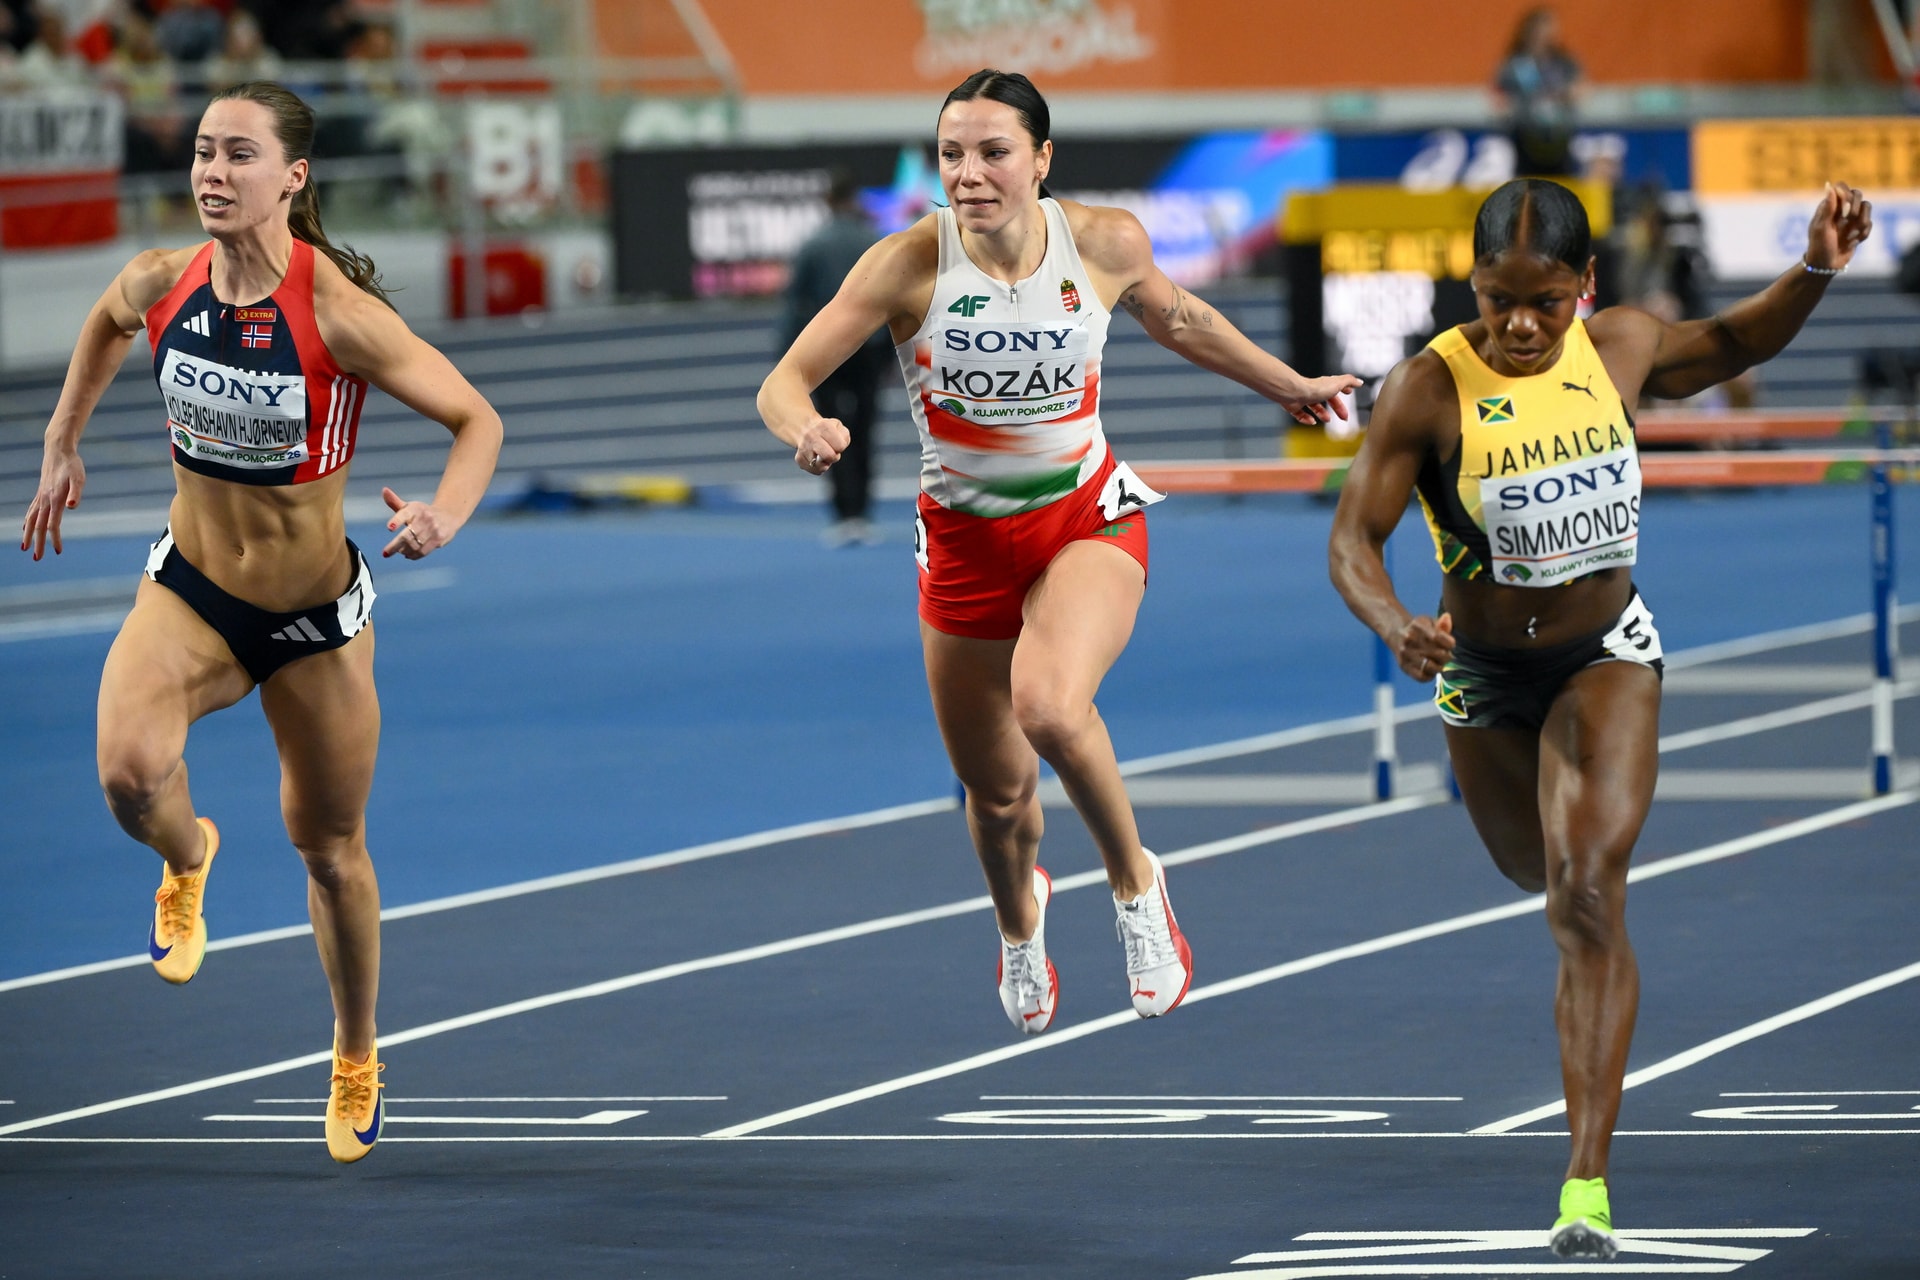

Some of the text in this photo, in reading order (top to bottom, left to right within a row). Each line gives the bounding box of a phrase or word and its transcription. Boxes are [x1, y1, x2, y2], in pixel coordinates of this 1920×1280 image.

[249, 311, 274, 319] EXTRA
[948, 295, 991, 317] 4F
[945, 328, 1073, 352] SONY
[173, 362, 289, 407] SONY
[941, 362, 1076, 397] KOZÁK
[972, 408, 1015, 418] KUJAWY
[1017, 402, 1065, 417] POMORZE
[239, 414, 302, 446] HJØRNEVIK
[197, 444, 302, 463] KUJAWY POMORZE 26
[1480, 424, 1624, 479] JAMAICA
[1499, 459, 1629, 511] SONY
[1496, 495, 1639, 556] SIMMONDS
[1541, 560, 1582, 578] KUJAWY
[1622, 615, 1652, 651] 5
